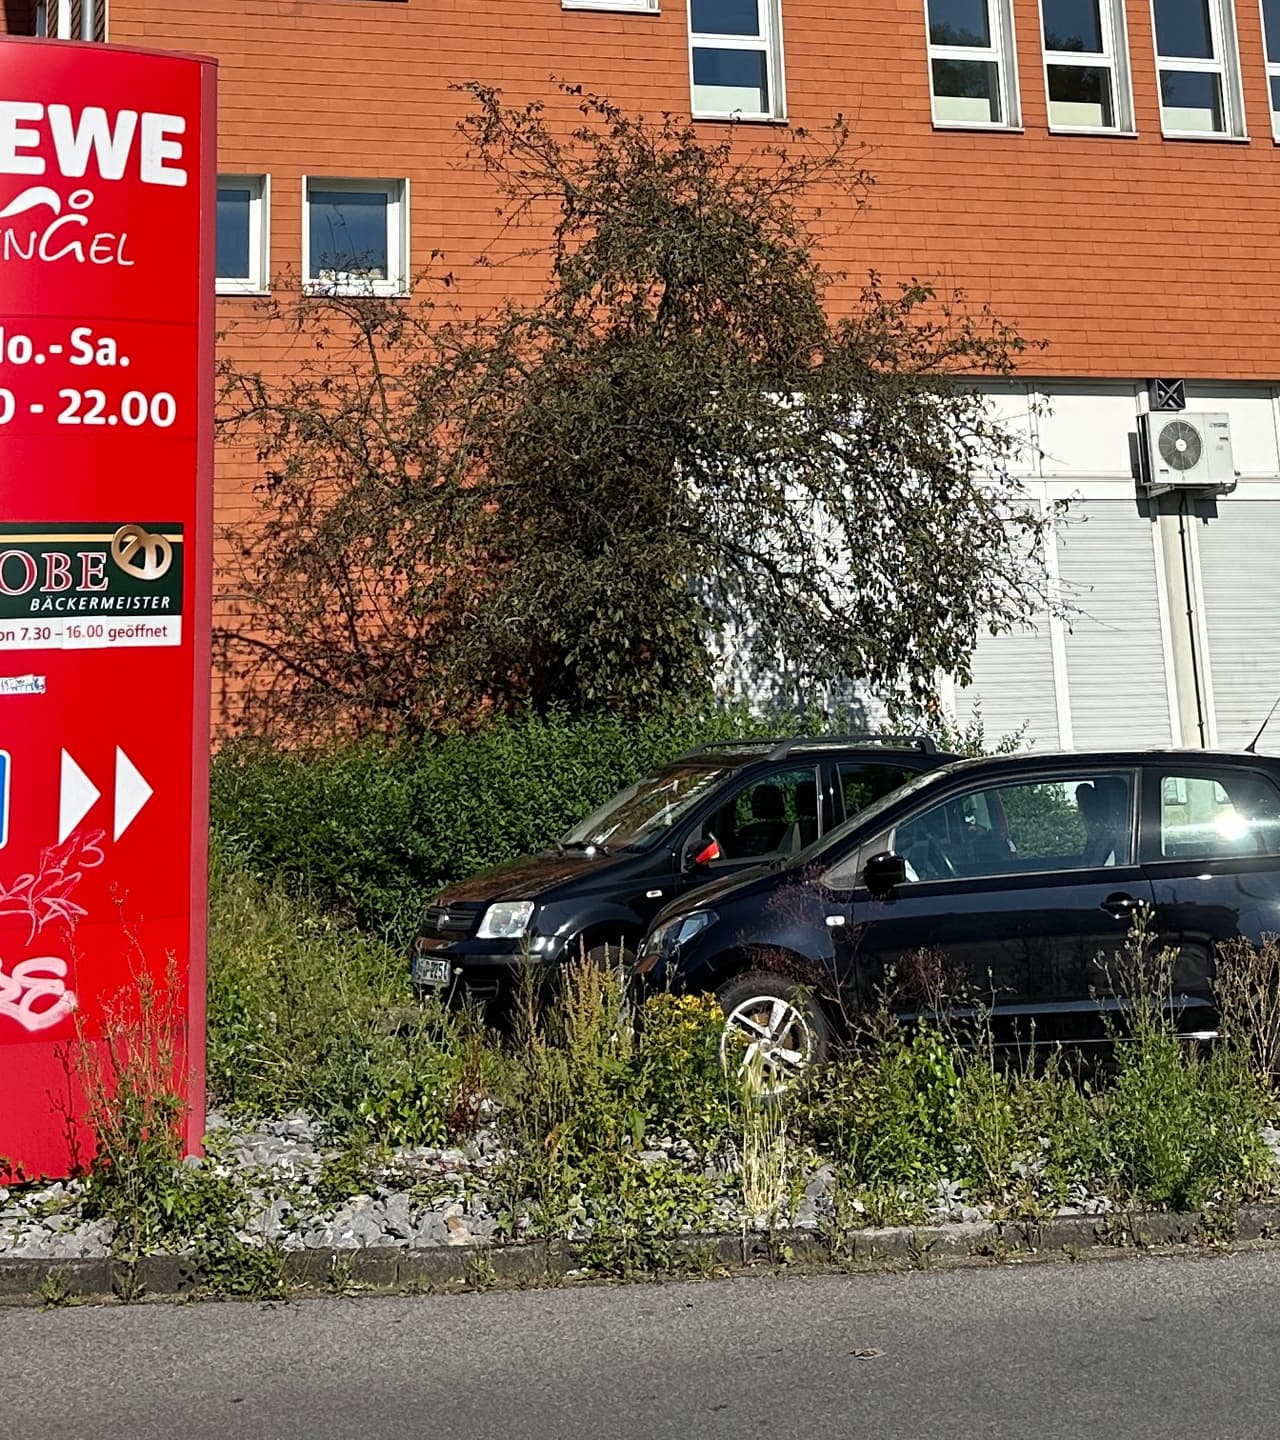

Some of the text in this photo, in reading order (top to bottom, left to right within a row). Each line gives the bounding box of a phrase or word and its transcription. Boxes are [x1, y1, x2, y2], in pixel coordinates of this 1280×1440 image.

[69, 327, 131, 367] Sa.
[30, 403, 45, 414] -
[57, 389, 177, 428] 22.00
[29, 595, 171, 612] BÄCKERMEISTER
[20, 627, 51, 641] 7.30
[66, 625, 104, 639] 16.00
[108, 624, 168, 641] geöffnet
